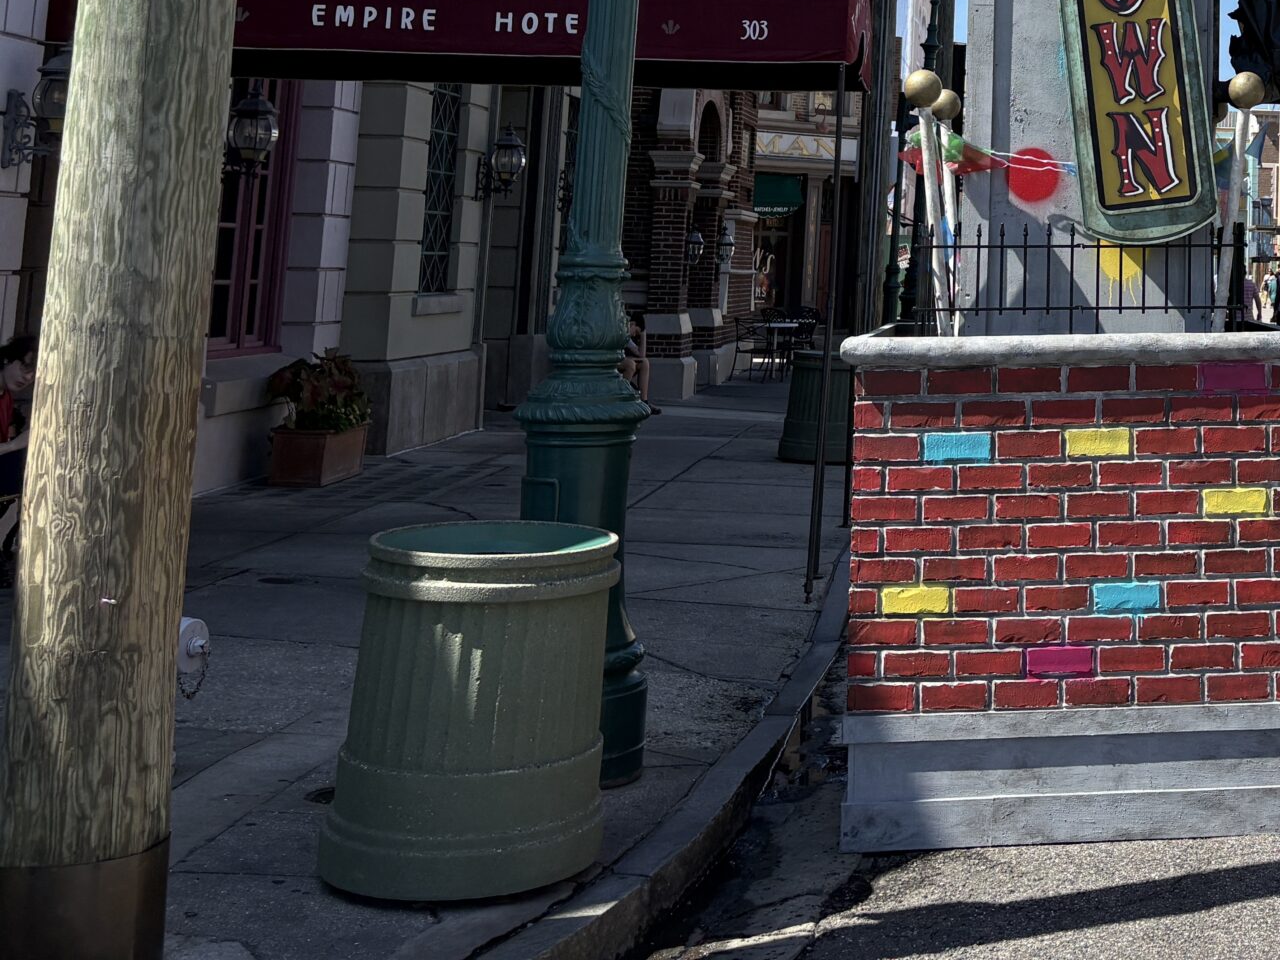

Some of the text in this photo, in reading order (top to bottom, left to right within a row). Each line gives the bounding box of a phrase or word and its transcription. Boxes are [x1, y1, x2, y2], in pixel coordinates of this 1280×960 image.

[311, 4, 580, 35] EMPIRE HOTE
[740, 19, 769, 40] 303
